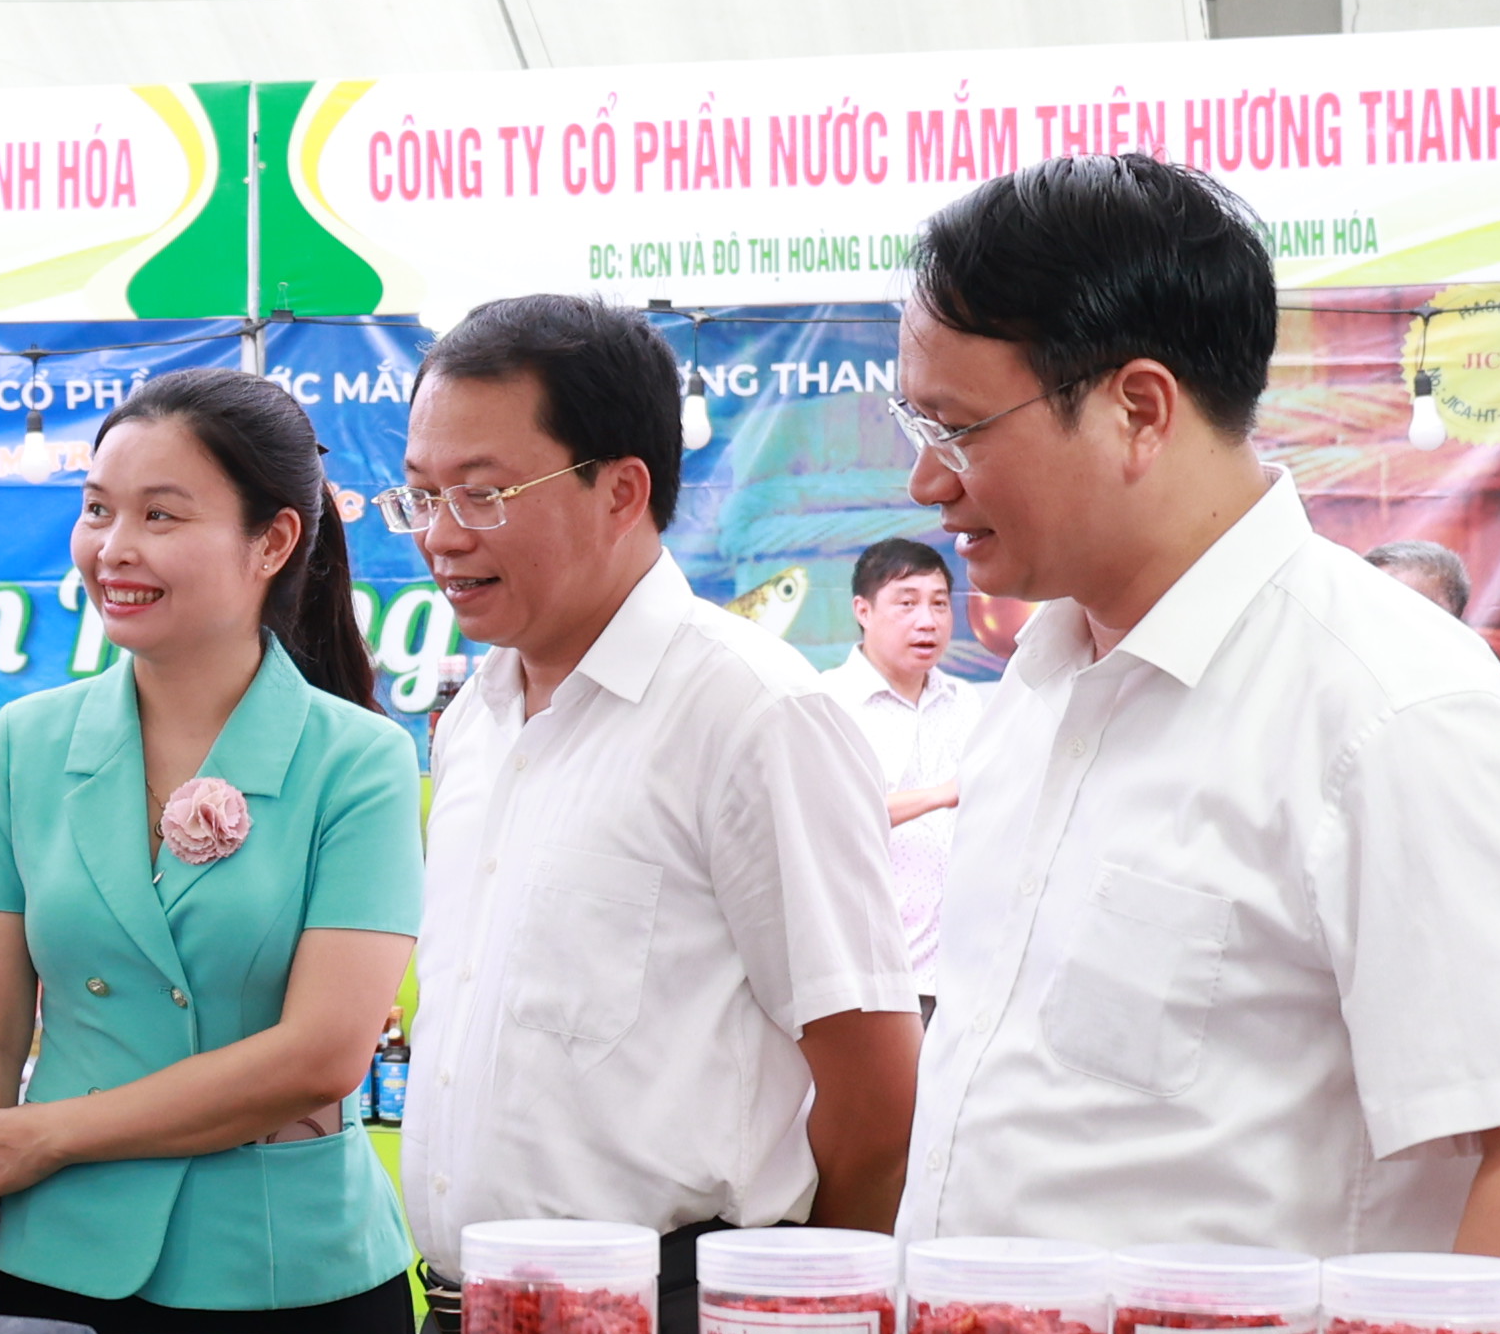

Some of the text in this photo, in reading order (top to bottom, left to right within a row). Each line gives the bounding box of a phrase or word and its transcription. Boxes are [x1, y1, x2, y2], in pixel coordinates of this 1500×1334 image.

[57, 123, 137, 210] HÓA
[368, 114, 483, 202] CÔNG
[499, 125, 545, 197] TY
[562, 91, 618, 196] CỔ
[634, 91, 751, 193] PHẦN
[769, 97, 889, 187] NƯỚC
[907, 79, 1018, 183] MẮM
[1036, 85, 1165, 162] THIÊN
[1184, 88, 1342, 173] HƯƠNG
[589, 243, 623, 279] ĐC:
[631, 241, 672, 278] KCN
[679, 233, 706, 276] VÀ
[712, 232, 740, 275] ĐÔ
[748, 237, 780, 283] THỊ
[788, 229, 860, 273] HOÀNG
[1333, 210, 1379, 255] HÓA
[6, 367, 53, 412] CỔ
[770, 360, 896, 395] THAN
